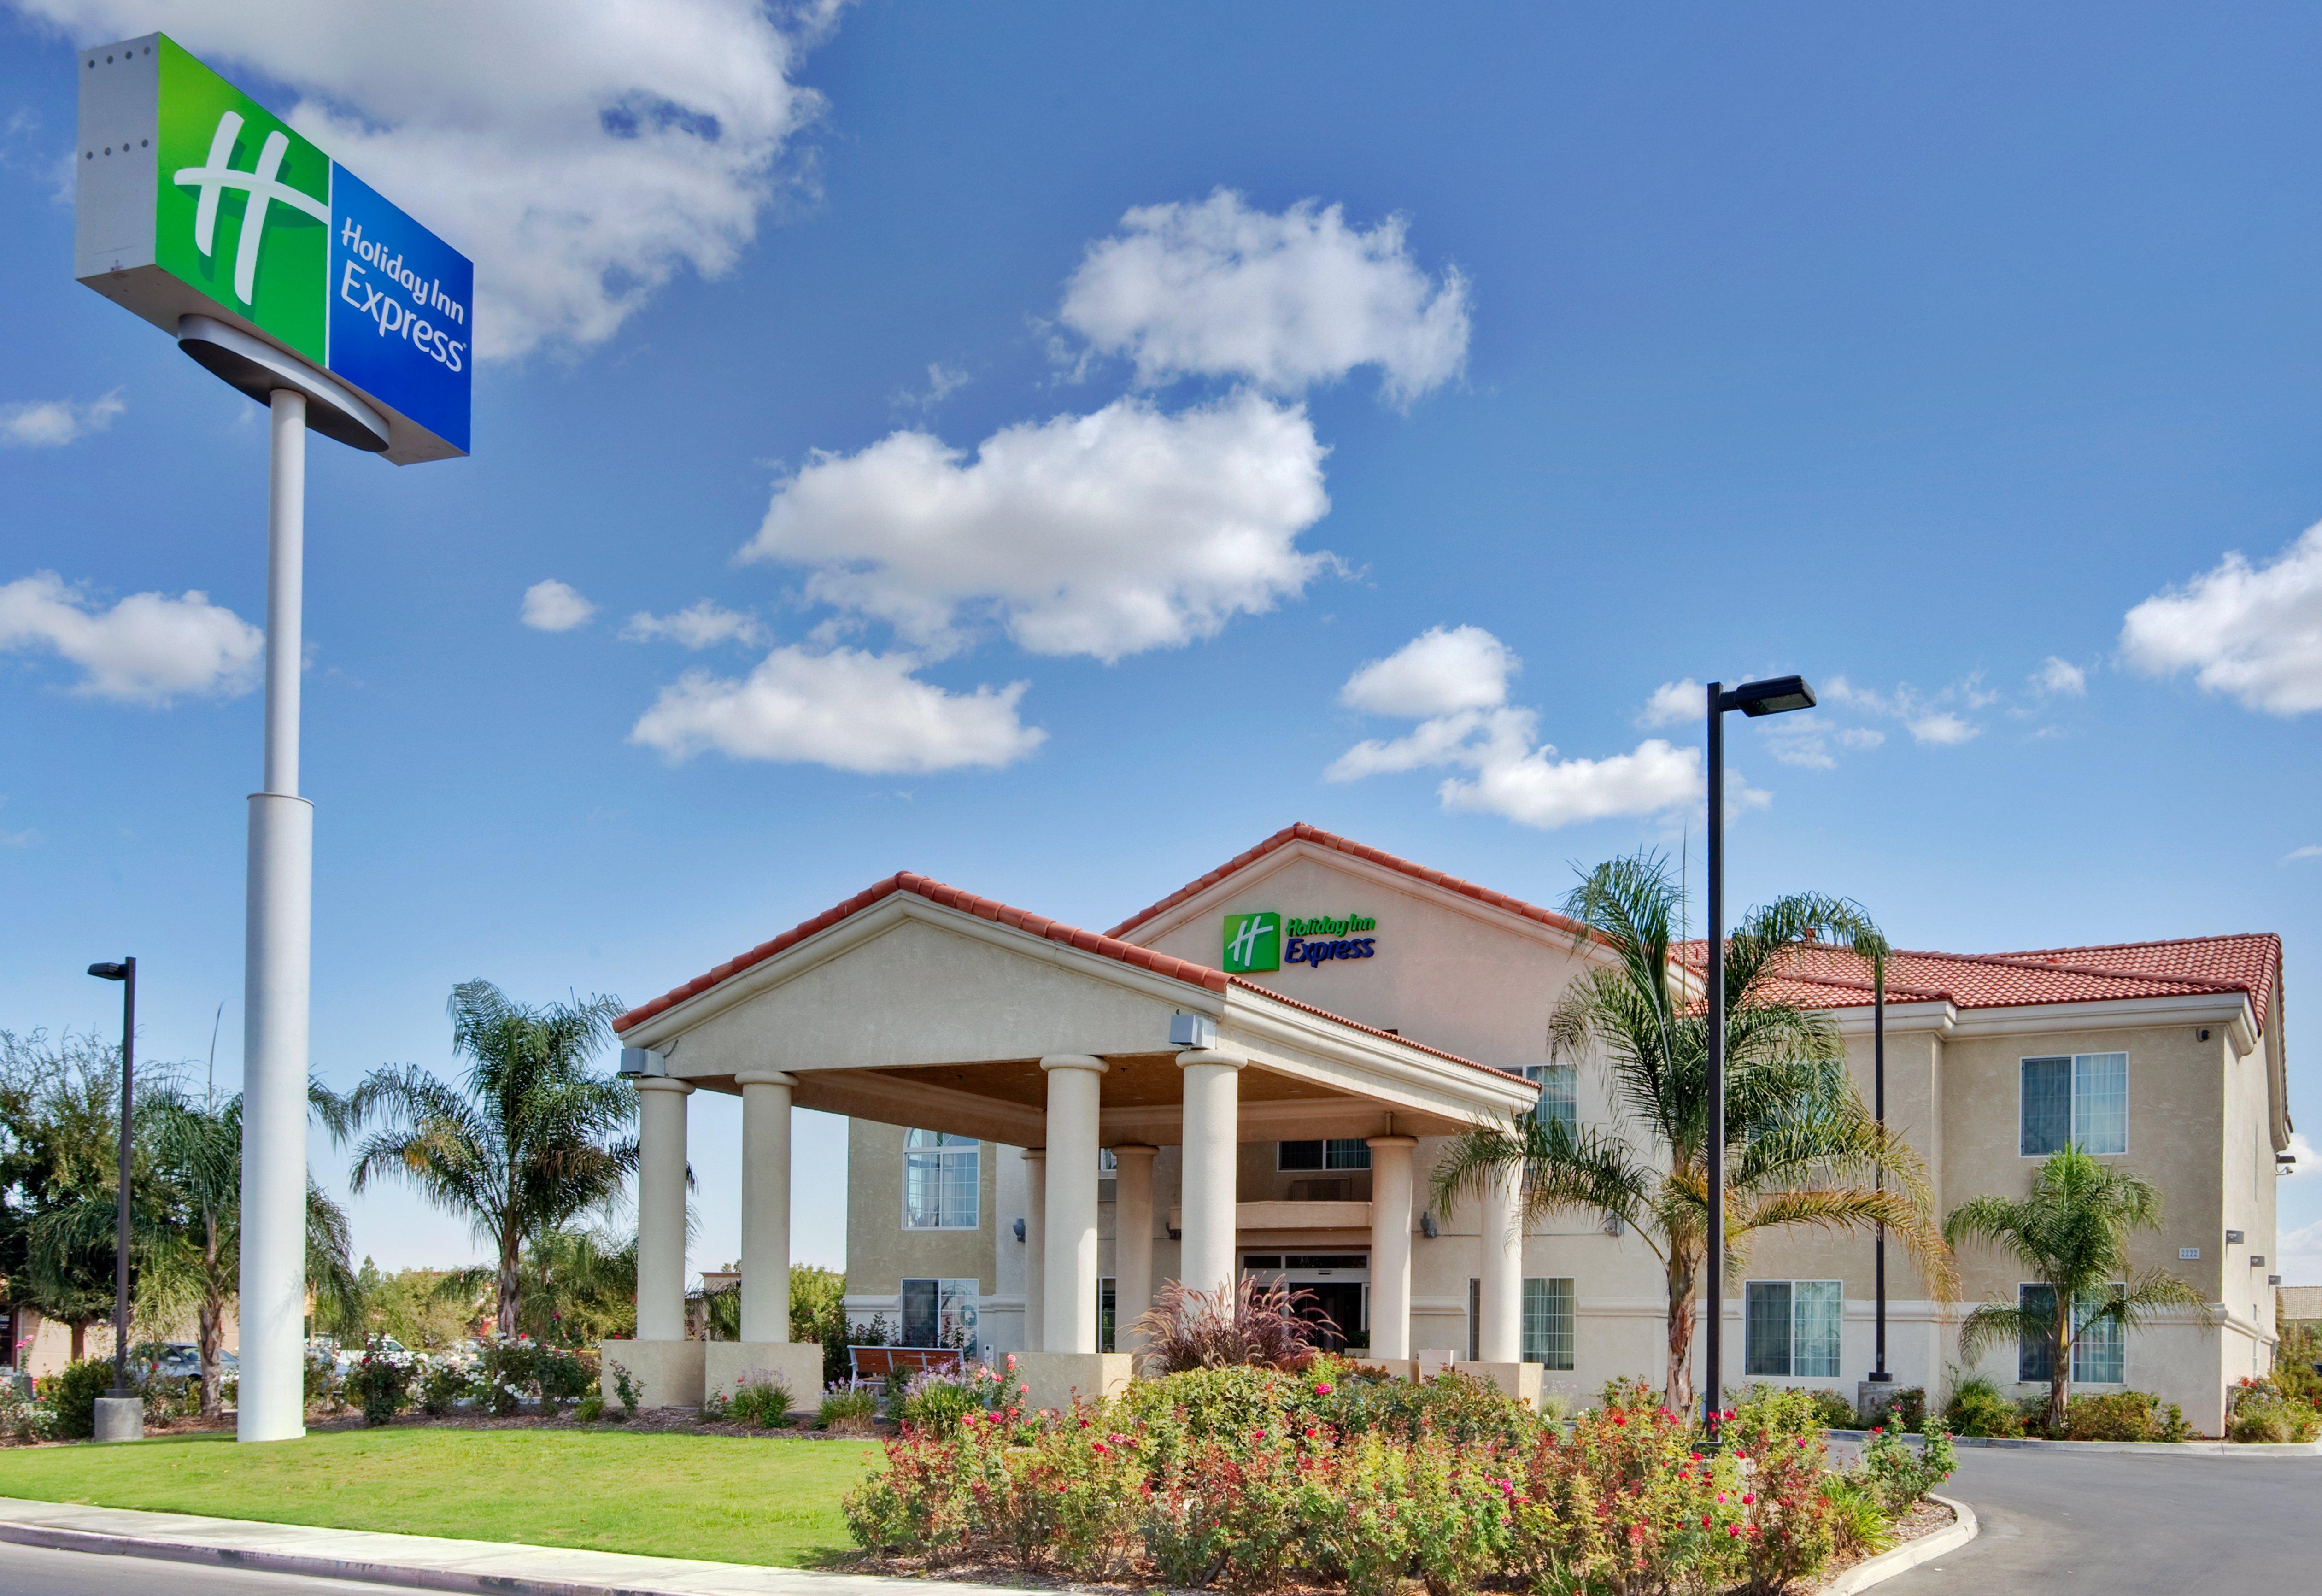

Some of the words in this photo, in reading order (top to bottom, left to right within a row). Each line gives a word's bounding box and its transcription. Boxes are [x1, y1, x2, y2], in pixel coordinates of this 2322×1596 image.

[341, 217, 429, 305] Holiday
[431, 278, 464, 325] Inn
[341, 259, 462, 372] Express
[1284, 938, 1376, 968] Express
[1285, 916, 1349, 937] Holiday
[1349, 913, 1376, 932] Inn
